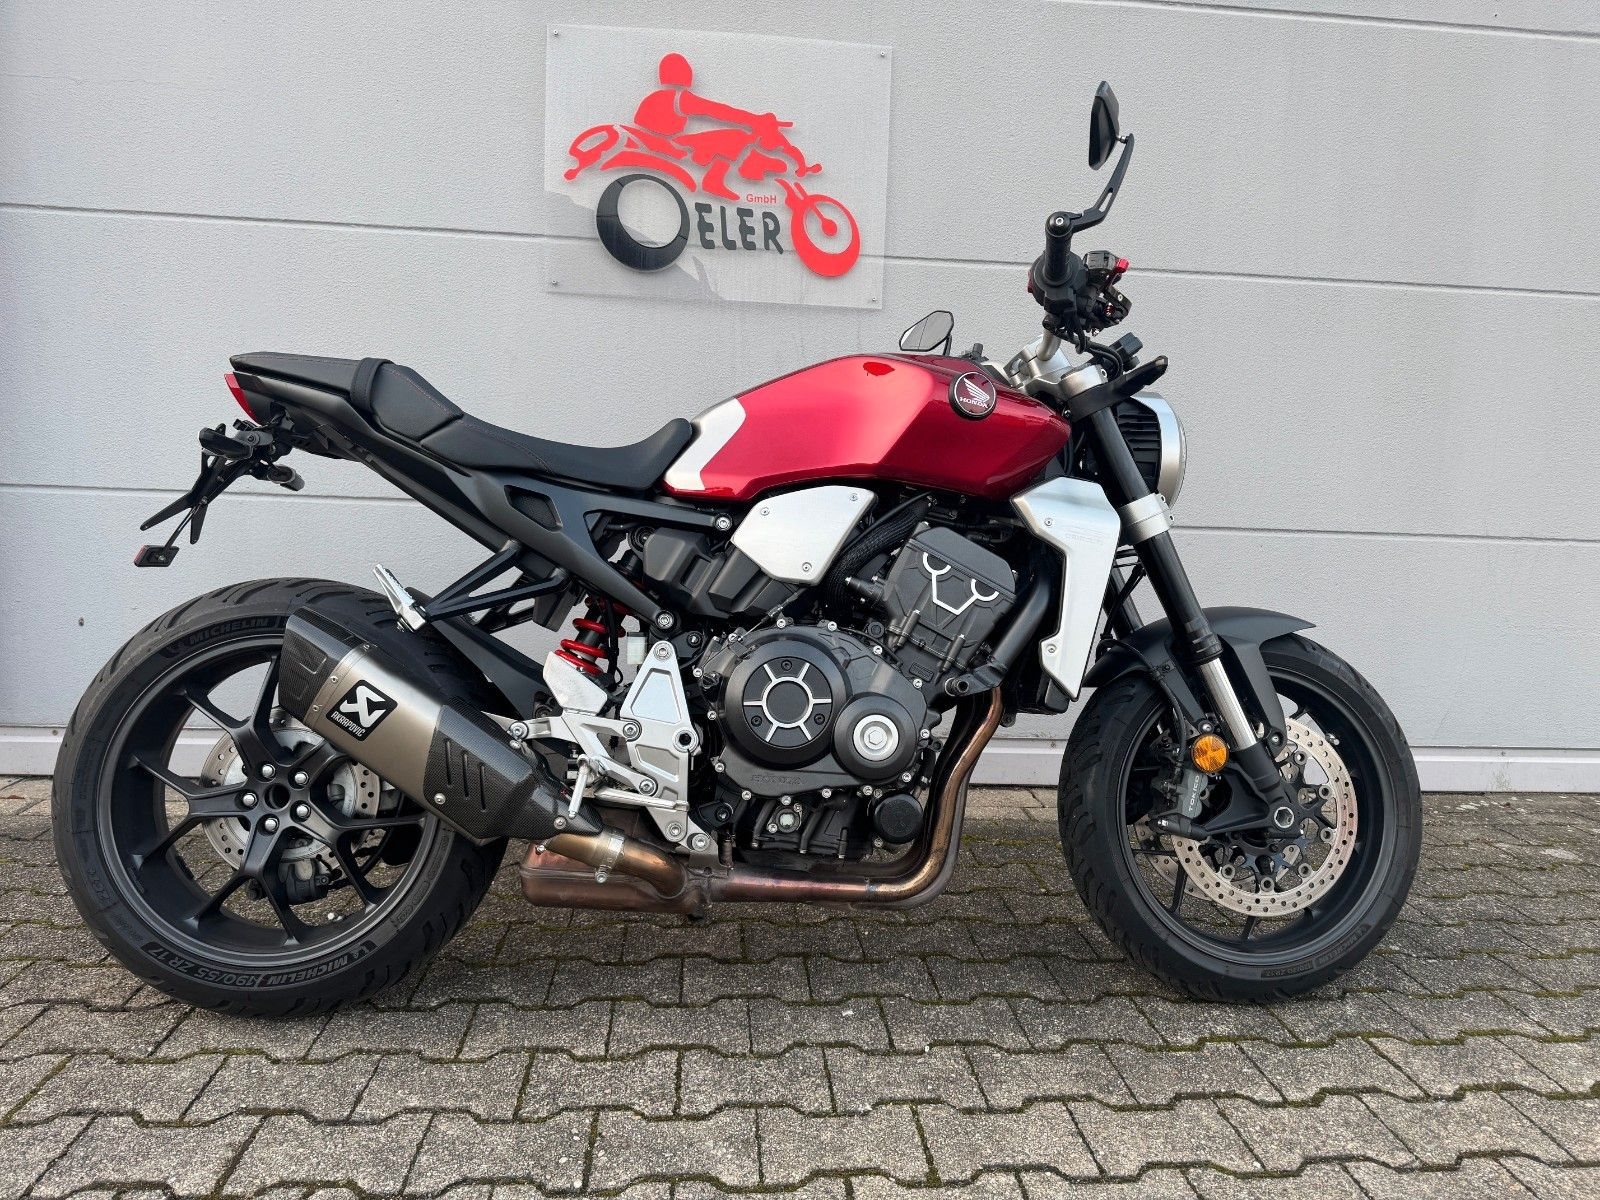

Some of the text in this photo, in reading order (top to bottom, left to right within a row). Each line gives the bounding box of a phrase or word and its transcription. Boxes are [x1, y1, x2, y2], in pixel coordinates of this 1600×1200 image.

[746, 193, 777, 204] GmbH
[960, 396, 989, 409] HONDA
[189, 617, 269, 646] MICHELIN
[148, 947, 167, 960] 17
[168, 956, 195, 973] ZR
[267, 955, 348, 985] MICHELIN
